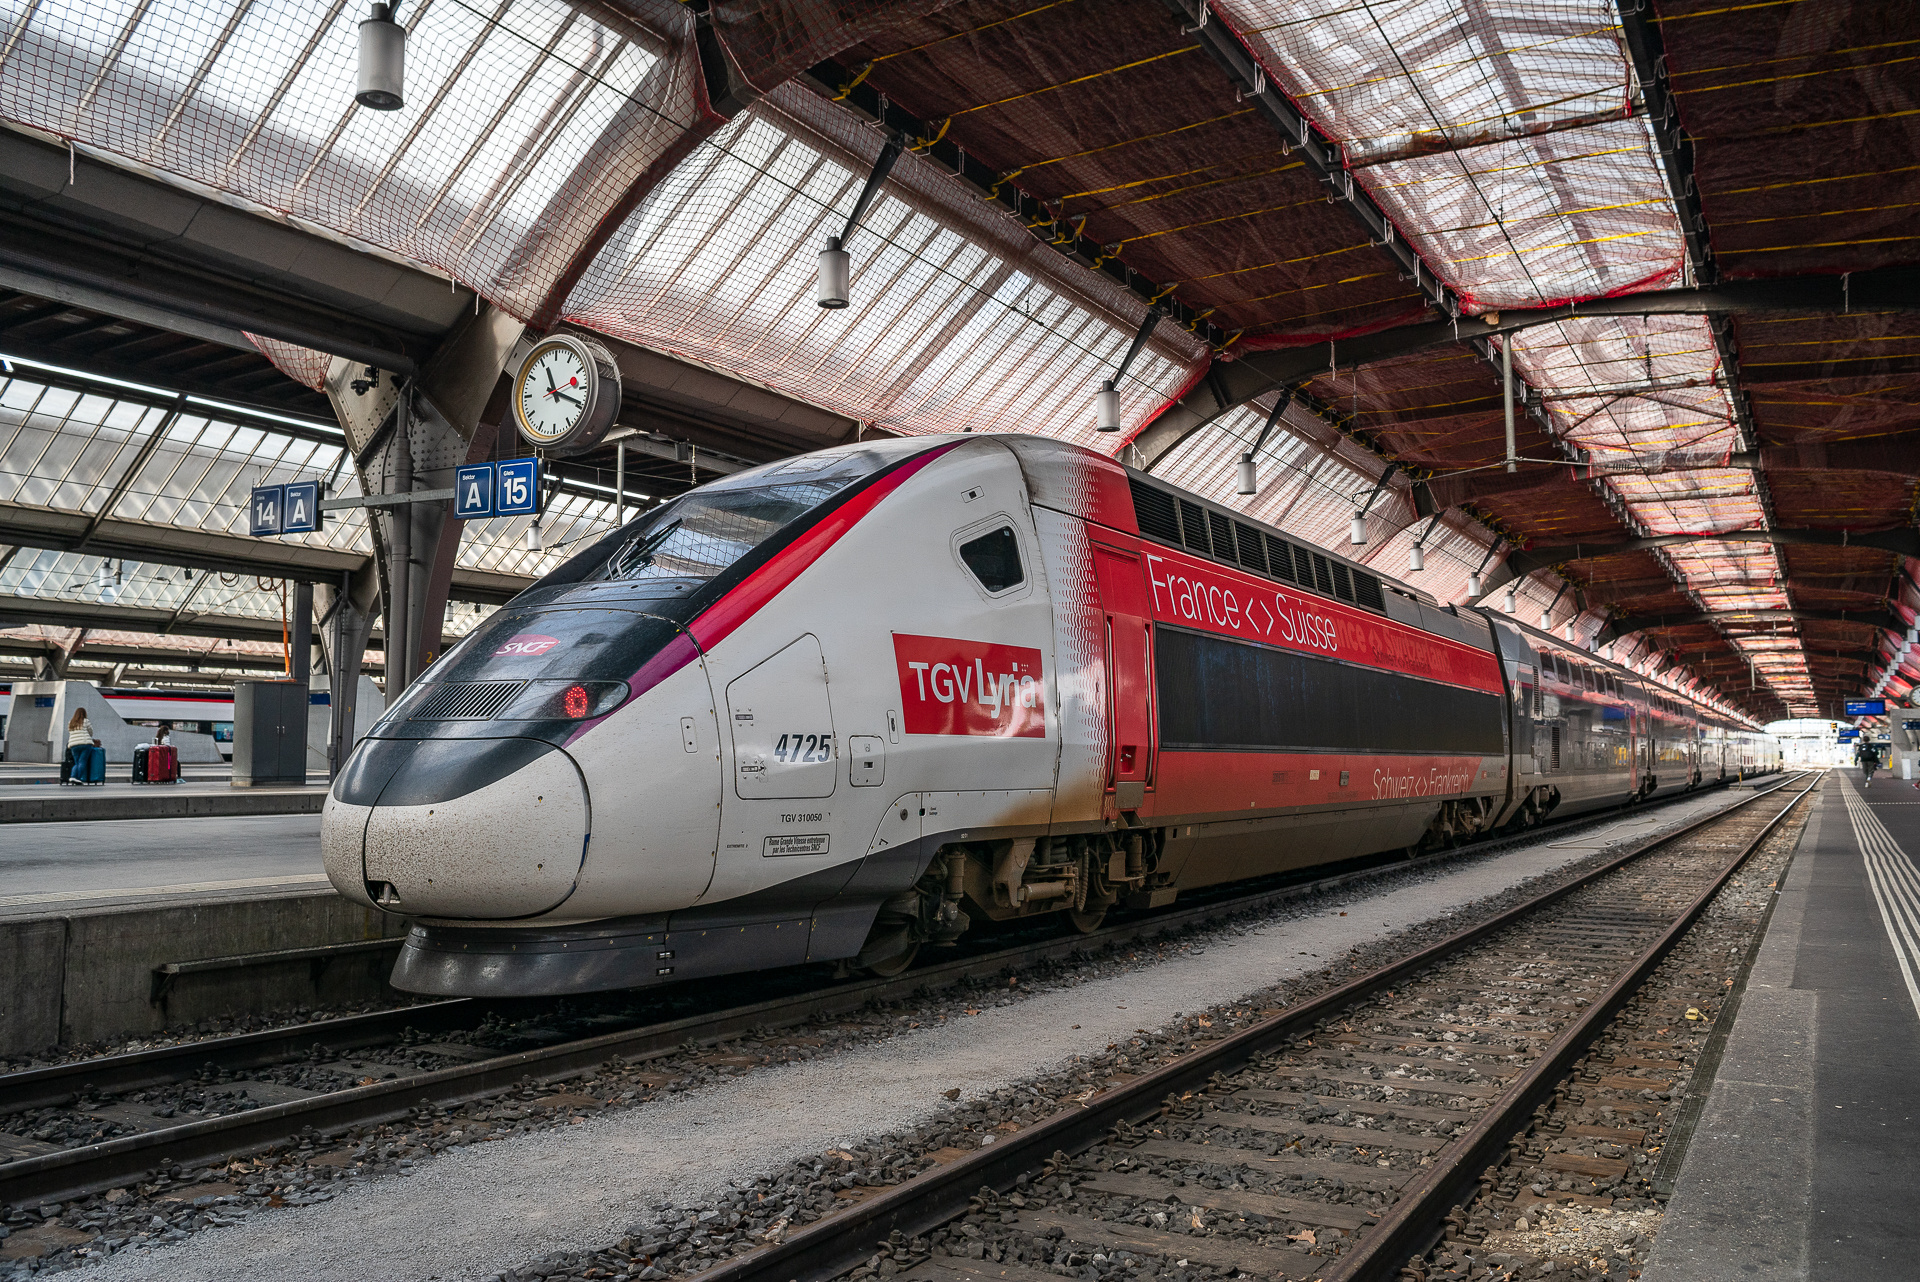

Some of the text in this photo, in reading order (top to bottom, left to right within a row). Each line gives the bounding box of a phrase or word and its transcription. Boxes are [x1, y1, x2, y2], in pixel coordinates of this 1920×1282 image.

[503, 469, 515, 477] Gleis
[465, 482, 482, 509] A
[503, 476, 528, 505] 15
[256, 501, 276, 526] 14
[292, 498, 306, 523] A
[1147, 554, 1240, 630] France
[1275, 593, 1338, 651] Suisse
[495, 642, 555, 655] SNCF
[908, 657, 1037, 719] TGV Lyria
[773, 733, 832, 763] 4725
[1371, 767, 1414, 800] Schweiz
[1429, 767, 1469, 796] Frankreich
[781, 813, 822, 823] TGV 310050
